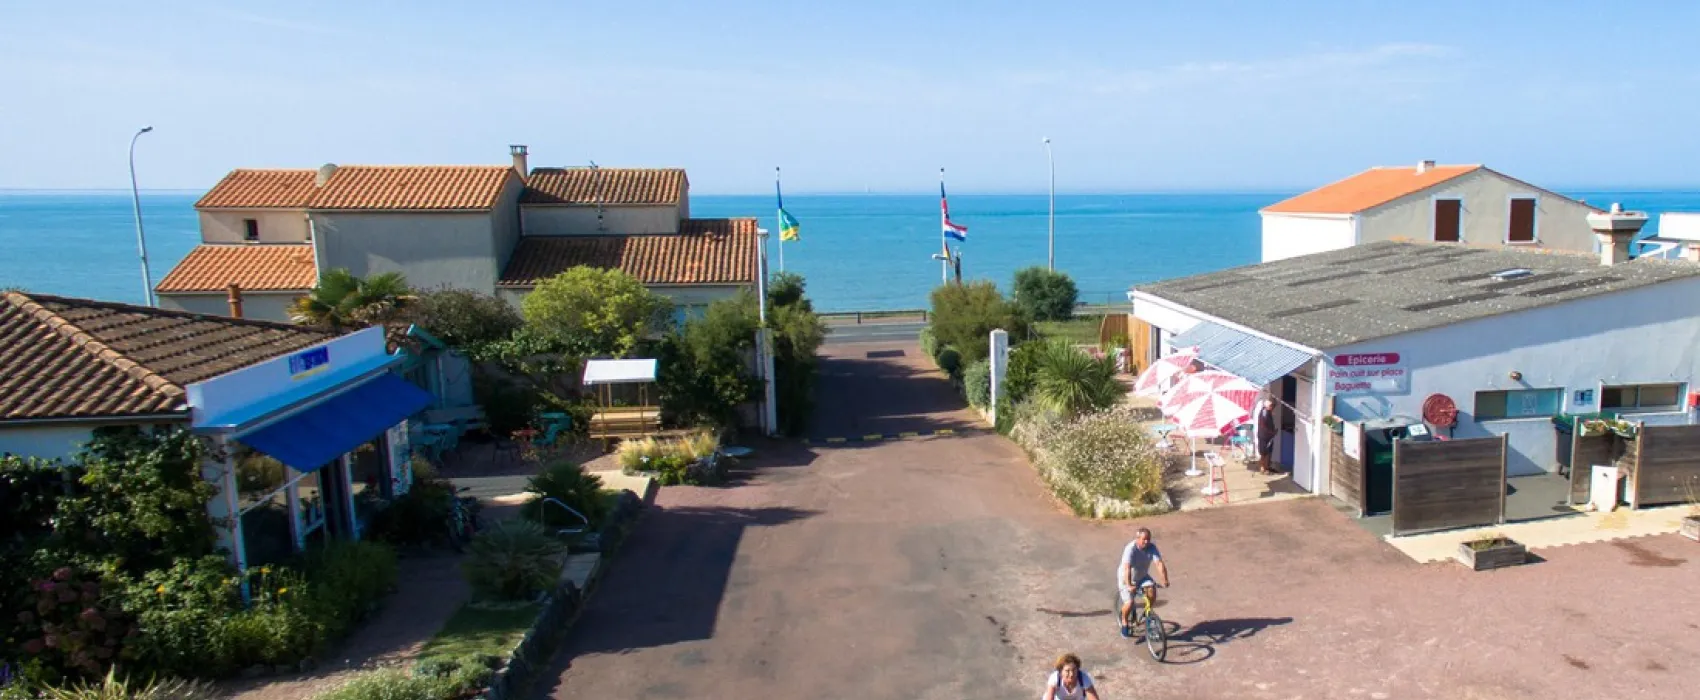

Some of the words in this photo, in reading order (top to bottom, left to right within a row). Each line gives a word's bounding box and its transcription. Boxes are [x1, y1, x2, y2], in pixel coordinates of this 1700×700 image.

[1348, 354, 1386, 366] Epicerie
[1329, 369, 1348, 378] Pain
[1351, 369, 1366, 377] cuit
[1367, 369, 1380, 377] sur
[1381, 368, 1403, 378] place
[1334, 381, 1372, 391] Baguette
